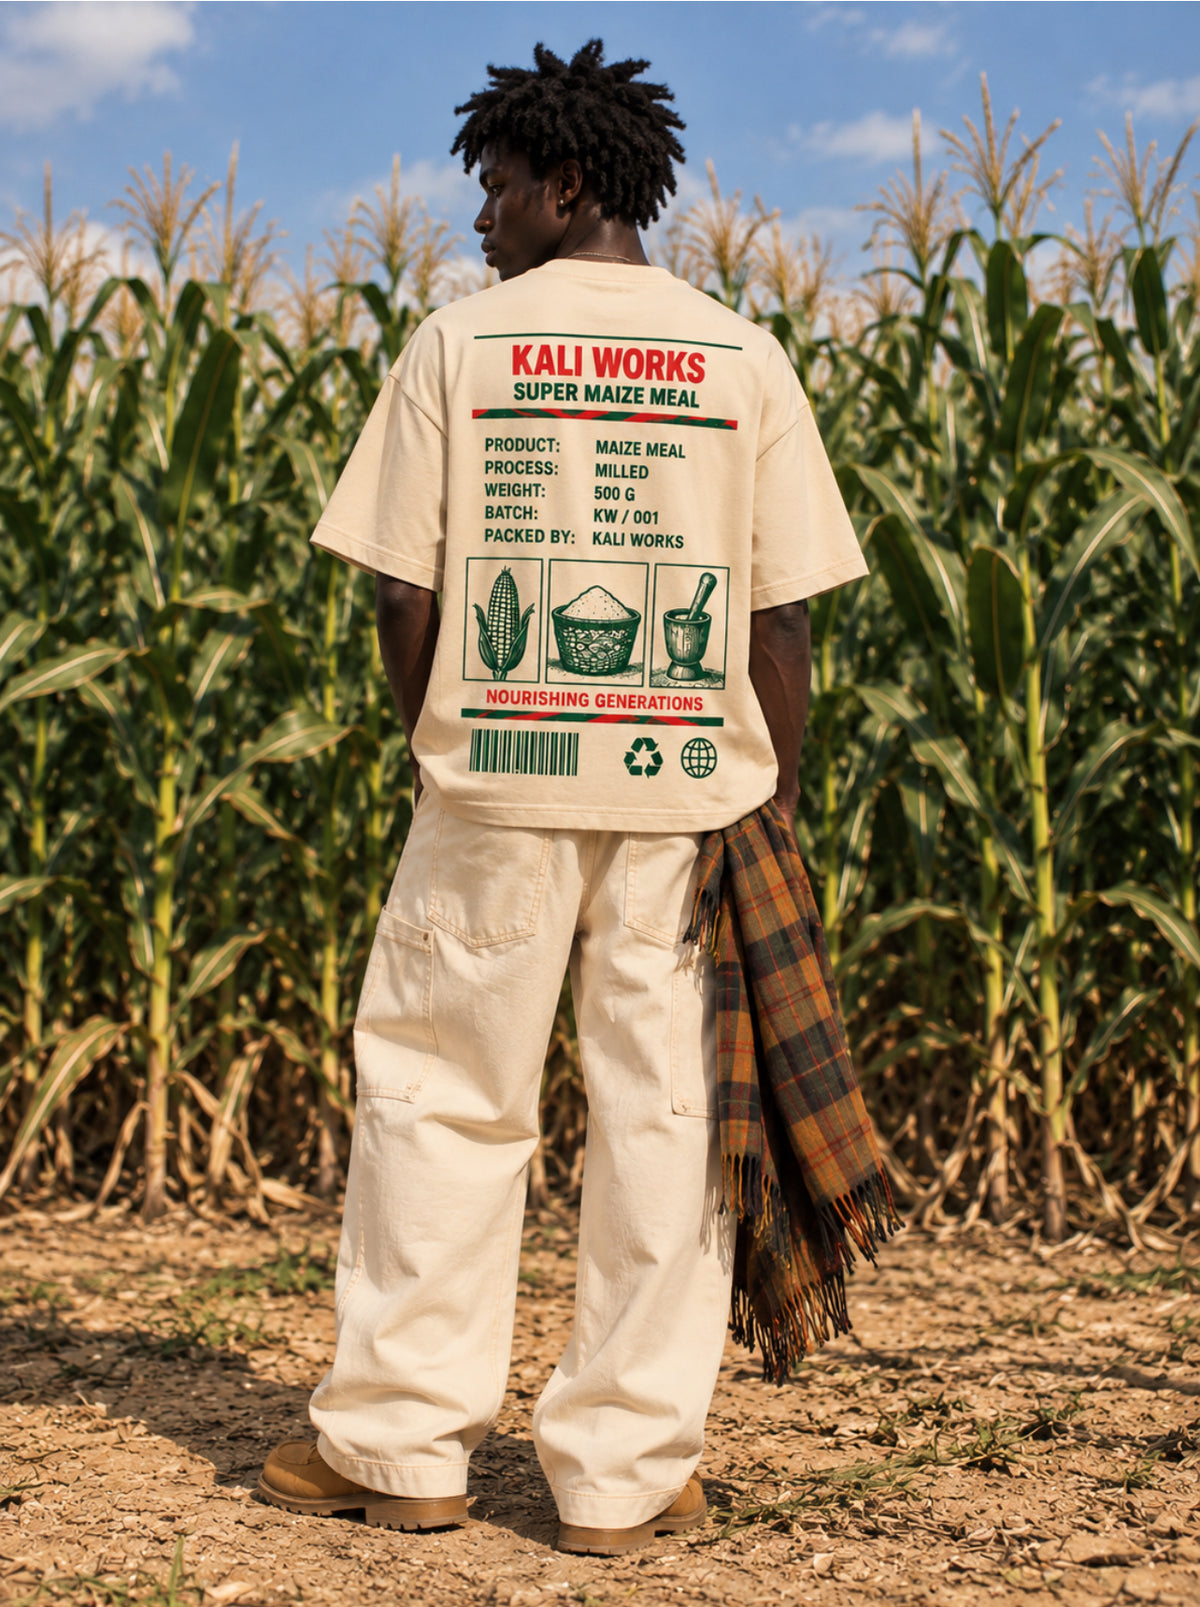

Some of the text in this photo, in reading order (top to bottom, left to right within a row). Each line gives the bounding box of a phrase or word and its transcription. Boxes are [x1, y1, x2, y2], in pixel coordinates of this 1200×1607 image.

[512, 344, 706, 385] KALI WORKS
[514, 382, 699, 408] SUPER MAIZE MEAL
[485, 437, 685, 458] PRODUCT: MAIZE MEAL
[485, 460, 649, 479] PROCESS: MILLED
[484, 483, 635, 501] WEIGHT: 500 G
[485, 505, 658, 525] BATCH: KW / 001
[485, 528, 684, 549] PACKED BY: KALI WORKS
[486, 689, 703, 711] NOURISHING GENERATIONS
